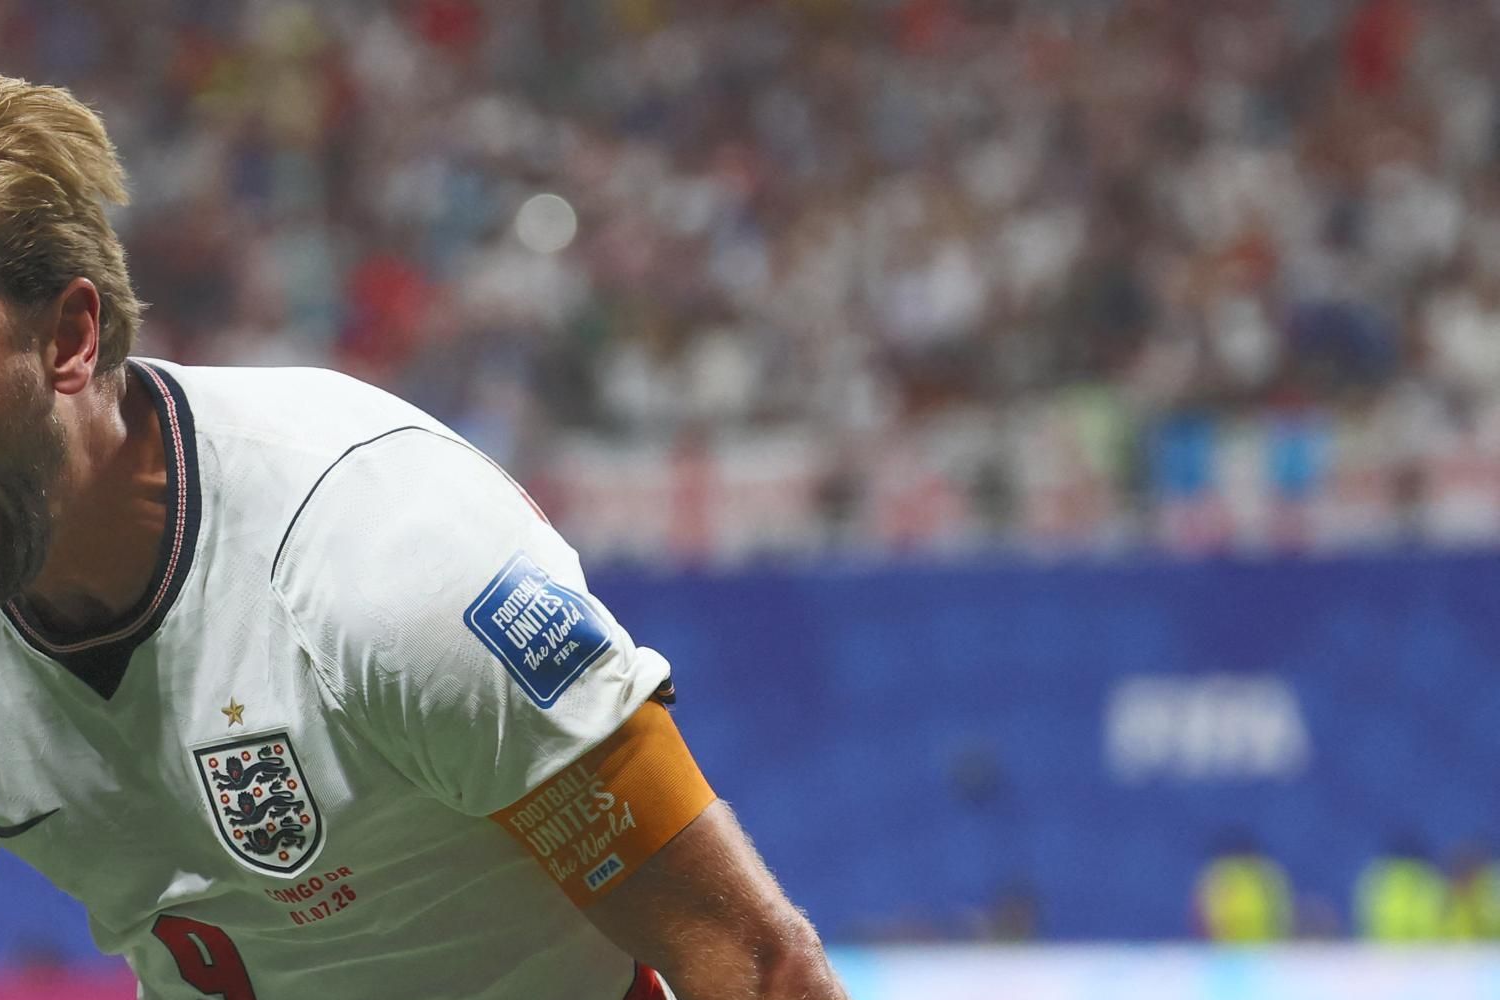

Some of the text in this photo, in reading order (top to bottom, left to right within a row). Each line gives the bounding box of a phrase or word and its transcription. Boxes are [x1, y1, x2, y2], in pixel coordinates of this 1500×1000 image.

[491, 575, 541, 631] FOOTBALL
[505, 589, 564, 650] UNITES
[523, 601, 585, 671] the World
[553, 640, 580, 666] FIFA
[509, 764, 597, 832] FOOTBALL
[526, 781, 615, 857] UNITES
[549, 801, 636, 882] the World
[324, 866, 353, 881] DR
[588, 859, 620, 887] FIFA
[290, 884, 357, 926] 01.07.26
